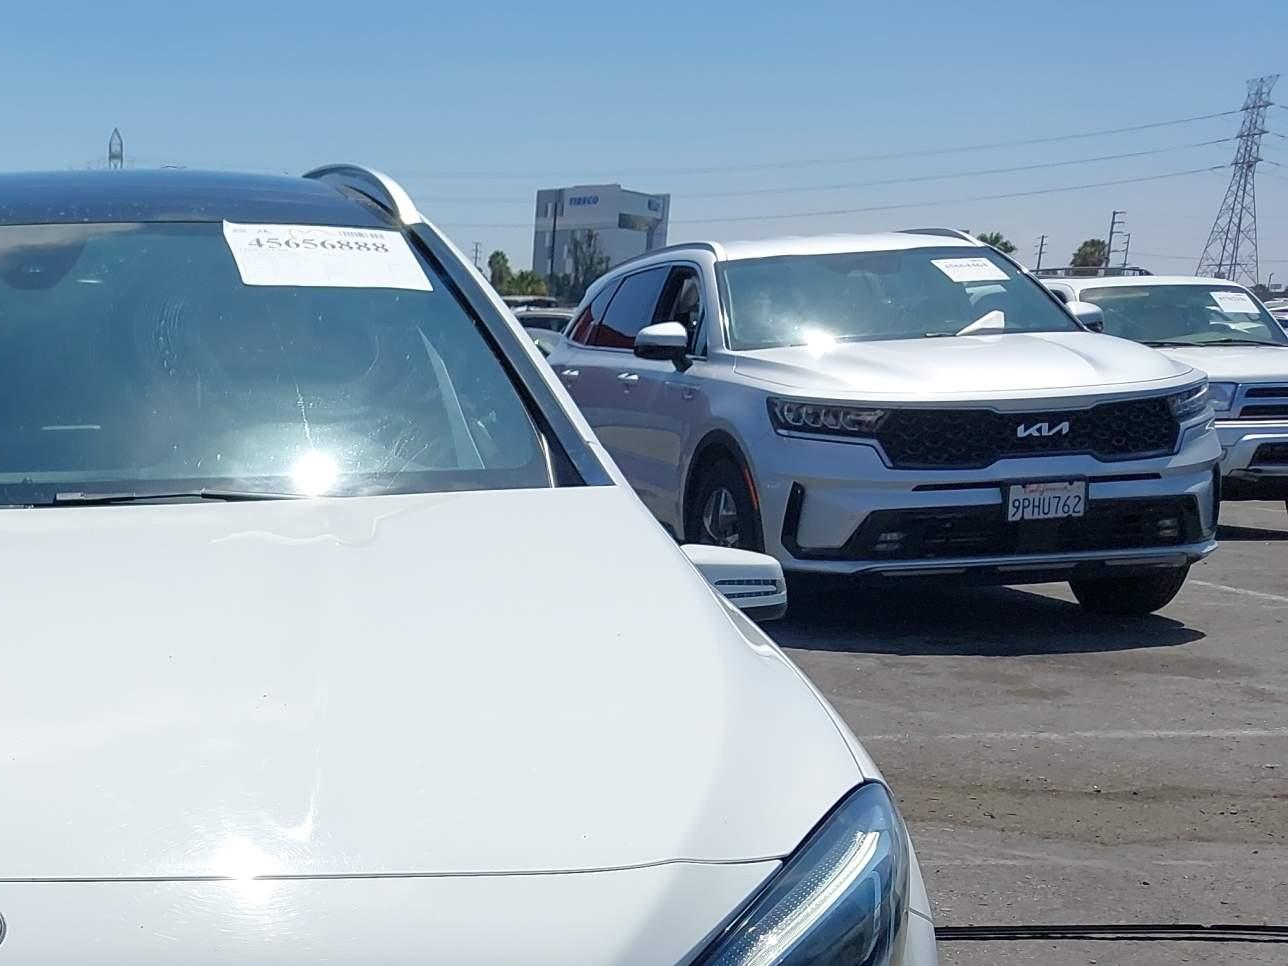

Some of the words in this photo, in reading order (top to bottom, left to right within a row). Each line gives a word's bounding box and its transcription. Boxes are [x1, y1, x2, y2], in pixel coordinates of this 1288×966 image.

[248, 237, 390, 253] 45656888
[1017, 422, 1070, 438] KIA
[1011, 495, 1082, 518] 9PHU762
